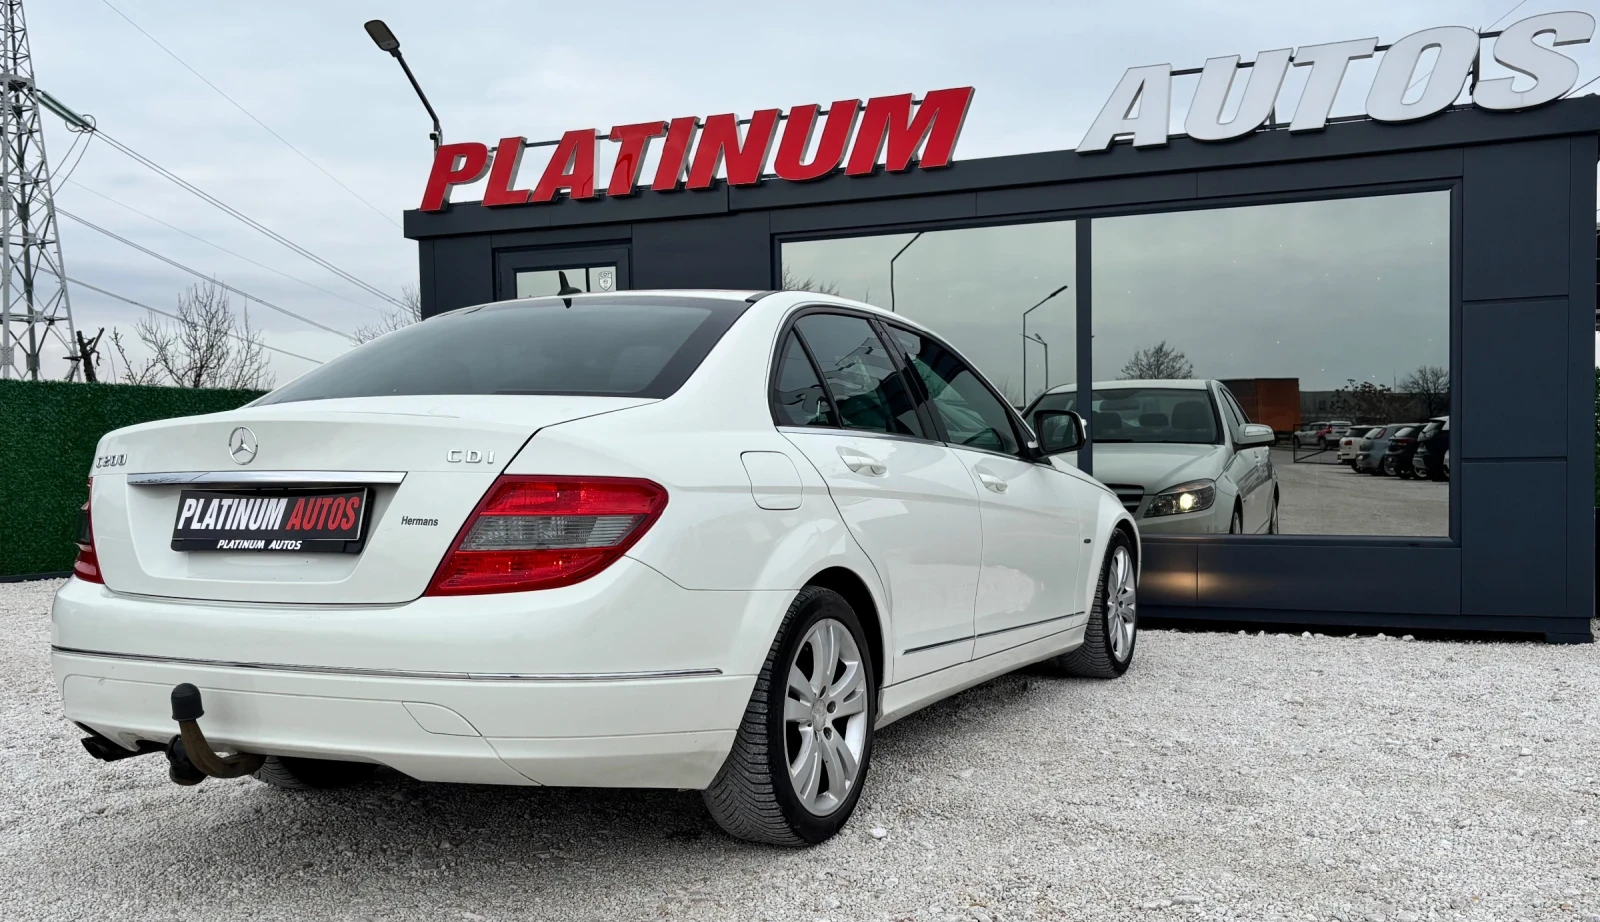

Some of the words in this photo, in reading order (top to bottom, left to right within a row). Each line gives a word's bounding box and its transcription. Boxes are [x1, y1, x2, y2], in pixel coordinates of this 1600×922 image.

[419, 86, 975, 212] PLATINUM
[1075, 10, 1596, 154] AUTOS
[447, 449, 495, 464] CDI
[177, 498, 288, 531] PLATINUM
[286, 497, 360, 531] AUTOS
[401, 515, 439, 526] Hermans
[217, 539, 265, 549] PLATINUM
[268, 540, 303, 550] AUTOS
